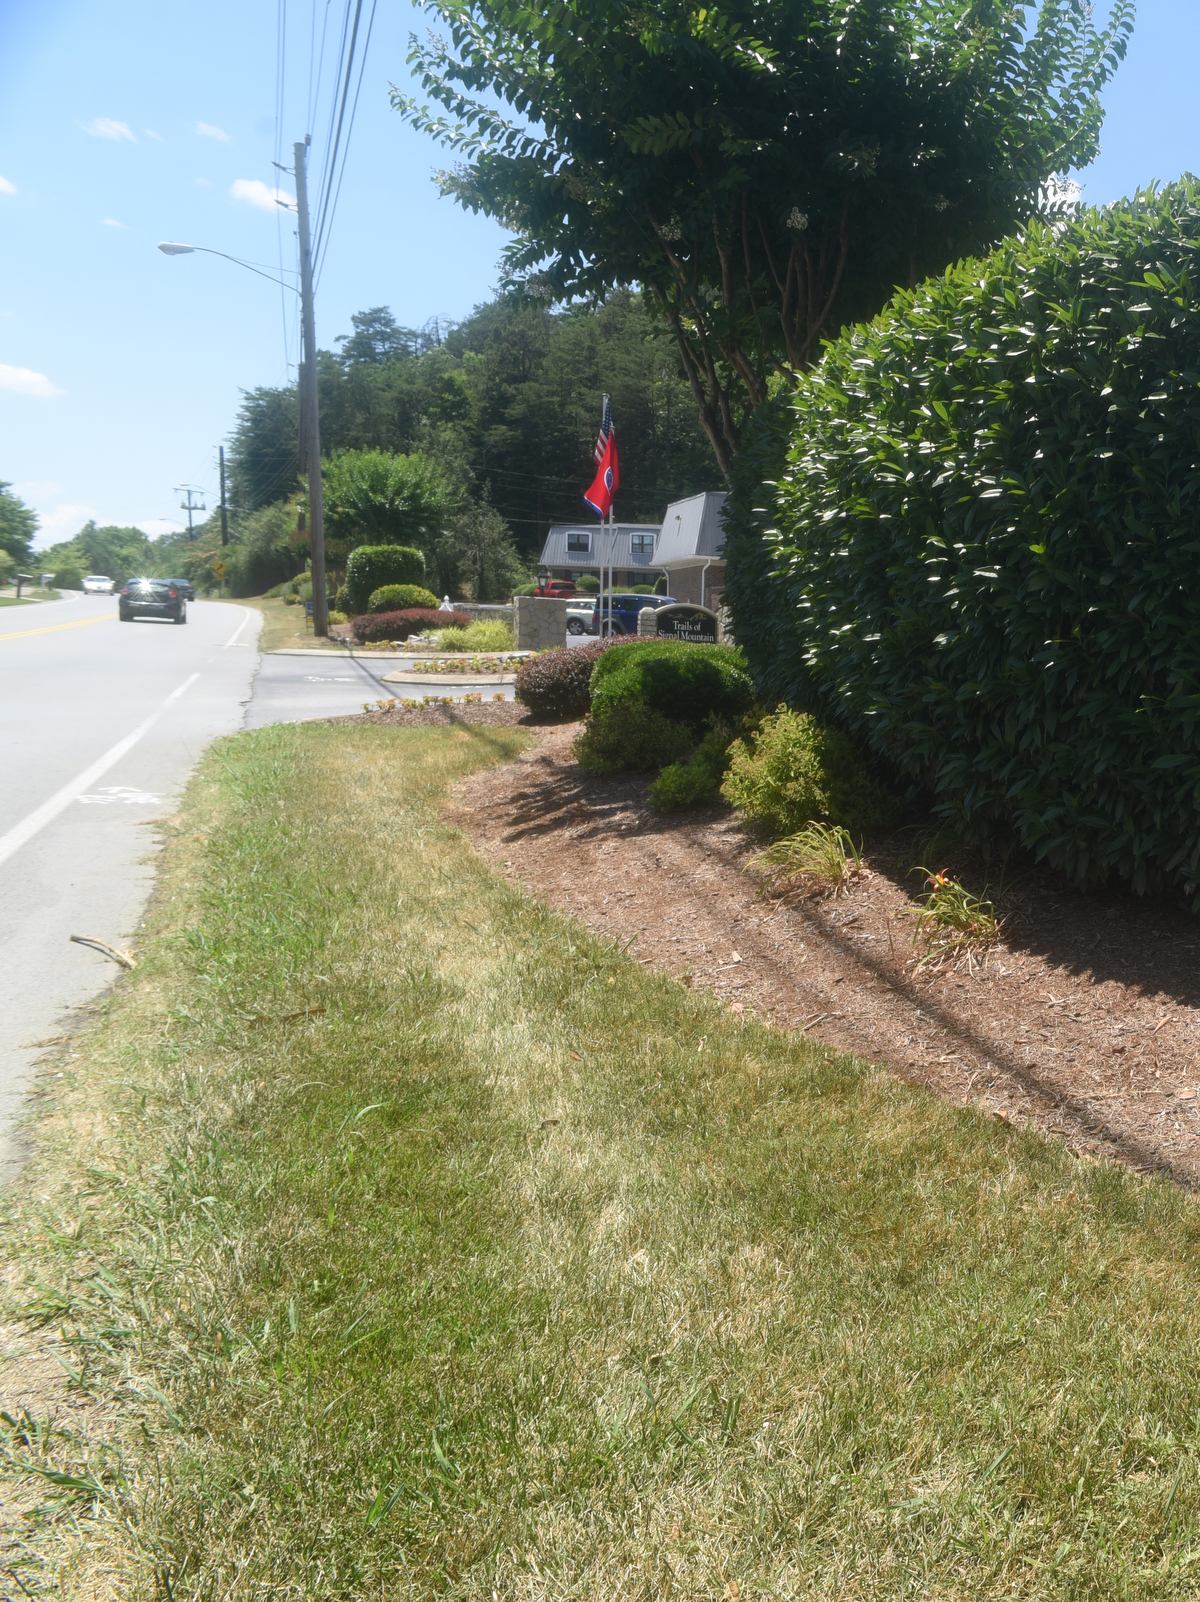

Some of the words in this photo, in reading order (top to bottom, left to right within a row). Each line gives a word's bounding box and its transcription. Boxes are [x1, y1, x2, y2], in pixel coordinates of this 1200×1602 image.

[672, 620, 693, 631] Trails
[693, 621, 702, 631] of
[680, 631, 714, 642] Mountain
